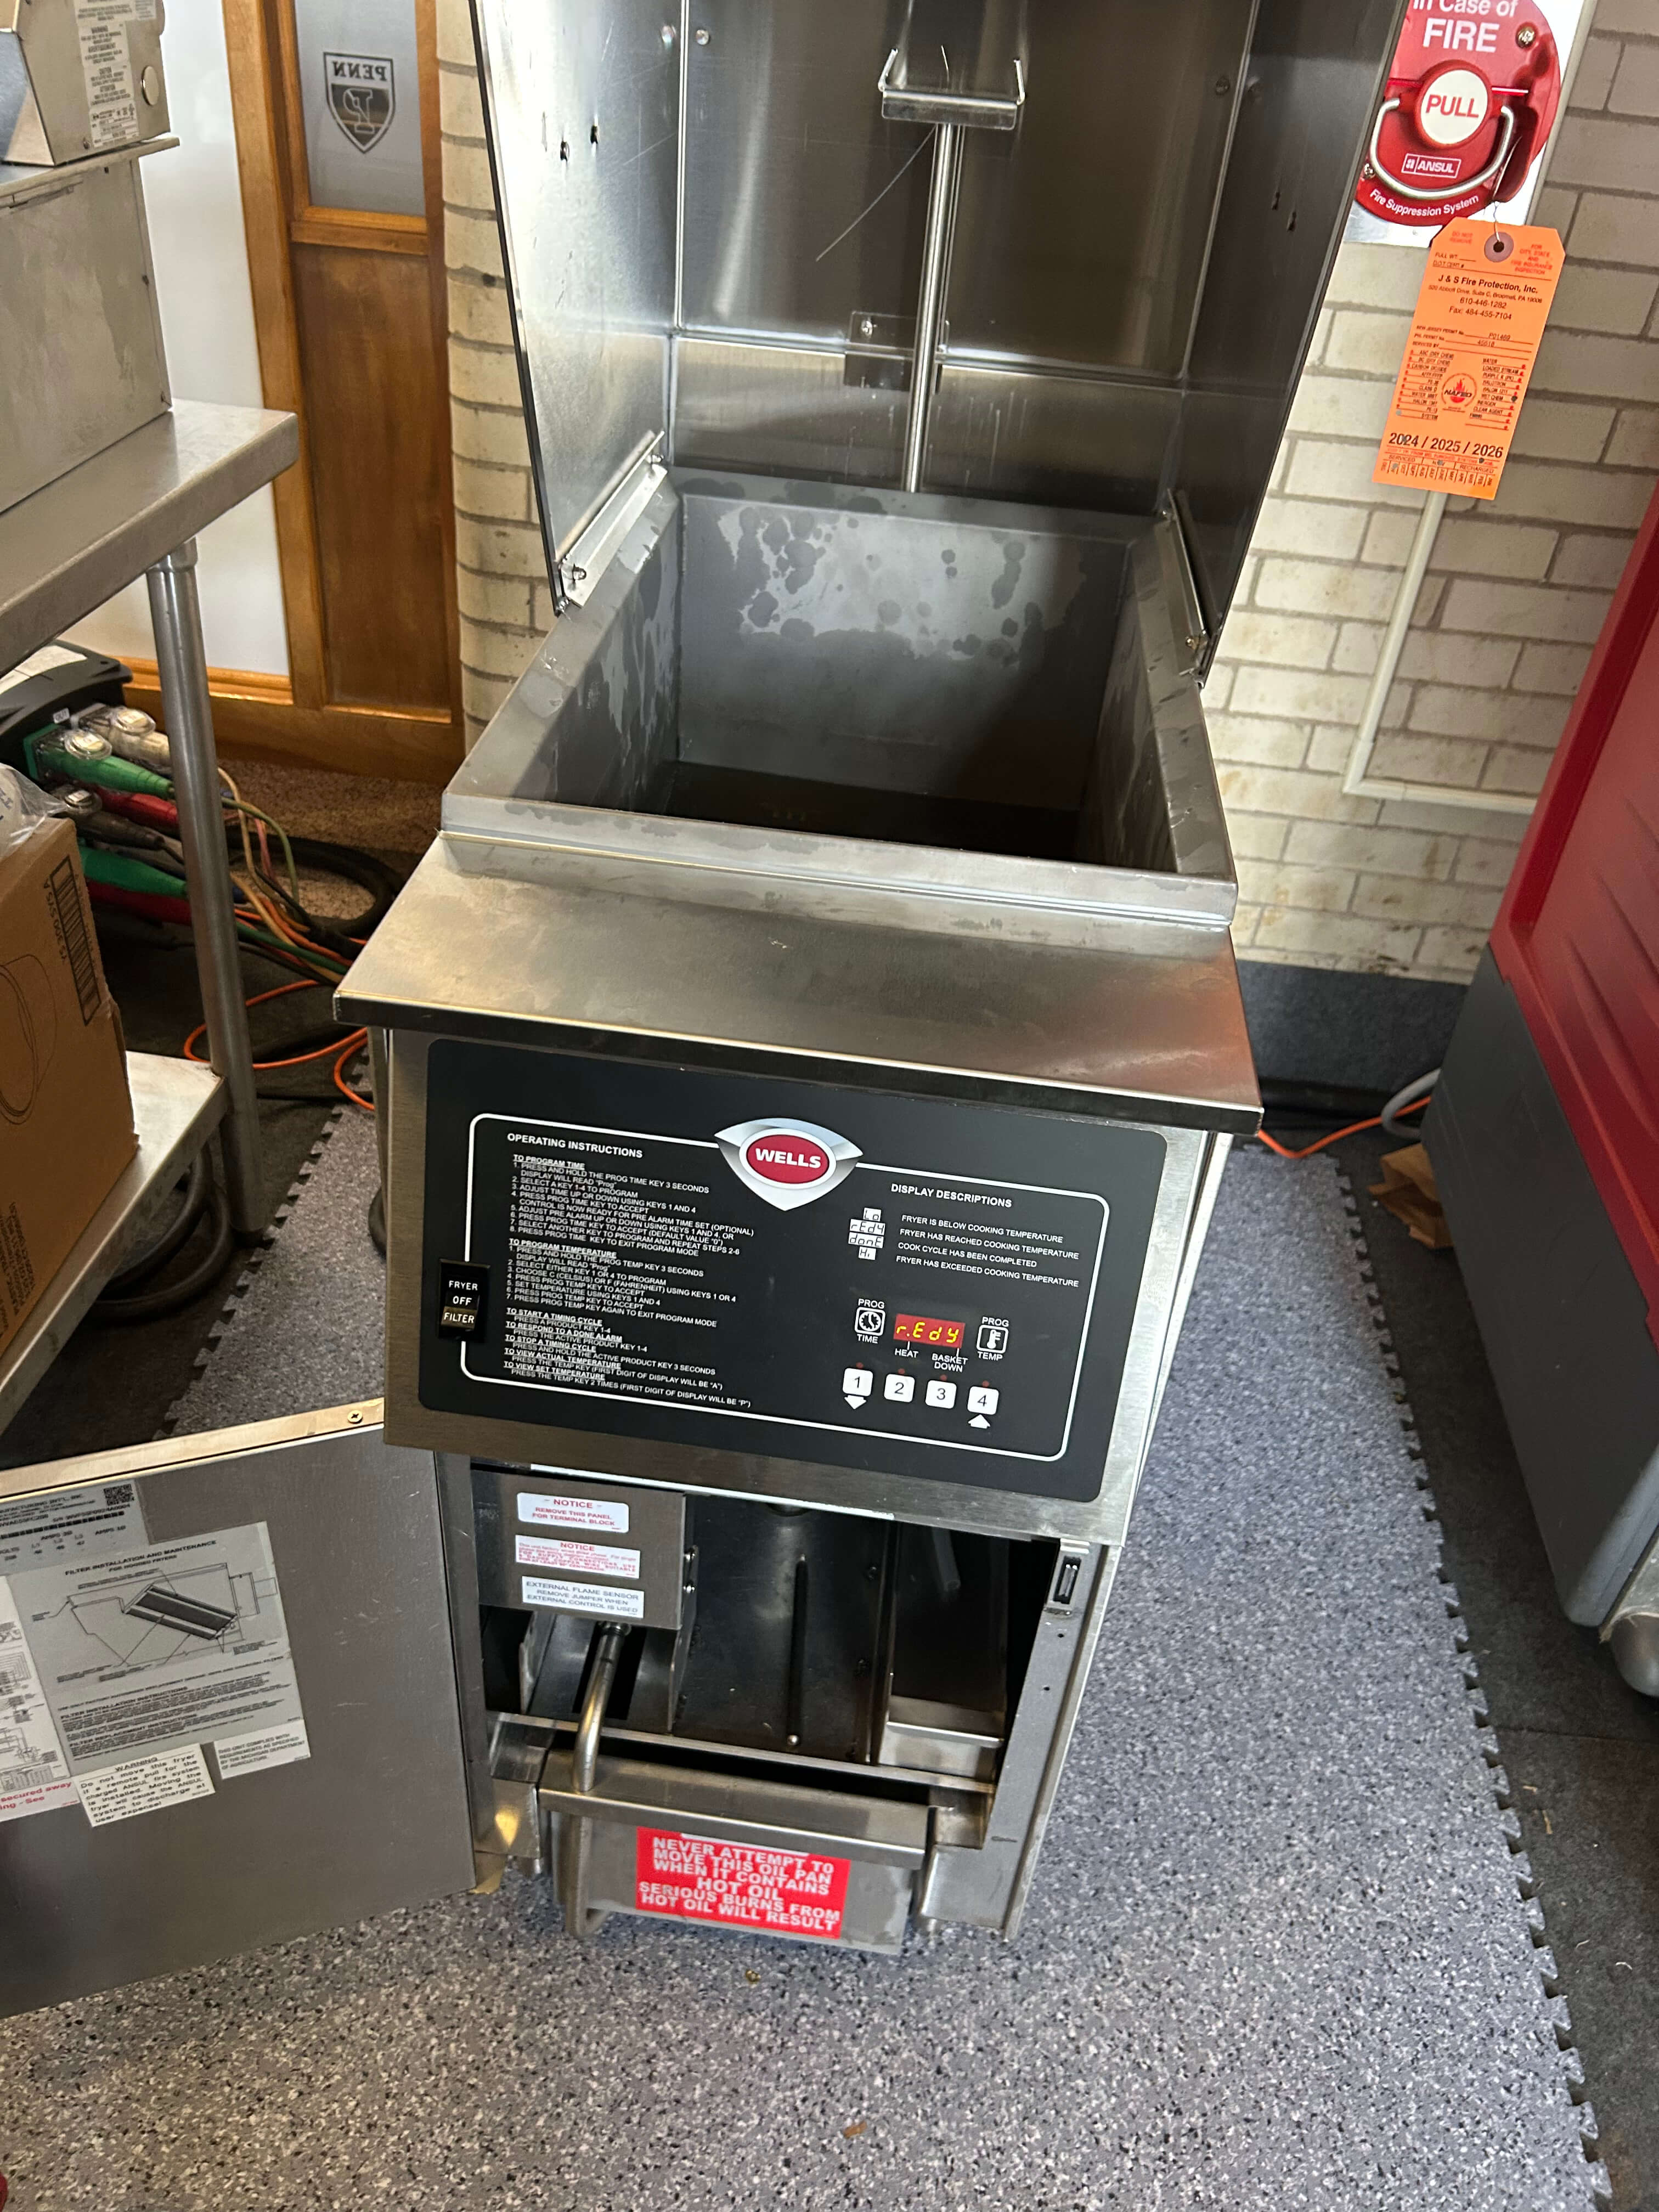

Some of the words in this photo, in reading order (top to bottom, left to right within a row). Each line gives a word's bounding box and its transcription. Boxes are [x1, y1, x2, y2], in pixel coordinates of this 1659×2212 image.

[1438, 0, 1491, 14] Case
[1496, 0, 1519, 17] of
[1423, 18, 1500, 53] FIRE
[1426, 94, 1479, 118] PULL
[1418, 160, 1454, 173] ANSUL
[1370, 189, 1386, 204] Fire
[1386, 199, 1441, 216] Suppression
[1443, 195, 1479, 215] System
[1462, 277, 1476, 286] Fire
[1479, 279, 1521, 293] Protection,
[1523, 285, 1538, 294] Inc.
[1449, 306, 1463, 314] Fax:
[1465, 308, 1512, 320] 484-455-7104
[1389, 432, 1419, 447] 2024
[1421, 436, 1429, 448] /
[1431, 438, 1461, 452] 2025
[1463, 441, 1470, 454] /
[1472, 443, 1503, 458] 2026
[507, 1133, 566, 1148] OPERATING
[568, 1141, 643, 1158] INSTRUCTIONS
[526, 1156, 565, 1166] PROGRAM
[567, 1161, 585, 1170] TIME
[755, 1148, 821, 1169] WELLS
[521, 1170, 552, 1180] DISPLAY
[521, 1163, 547, 1172] PRESS
[606, 1174, 628, 1182] PROG
[629, 1177, 647, 1185] TIME
[672, 1183, 709, 1193] SECONDS
[891, 1184, 934, 1197] DISPLAY
[936, 1189, 1012, 1207] DESCRIPTIONS
[902, 1215, 928, 1224] FRYER
[939, 1220, 966, 1229] BELOW
[968, 1224, 1004, 1235] COOKING
[1006, 1229, 1063, 1243] TEMPERATURE
[521, 1240, 560, 1251] PROGRAM
[562, 1245, 617, 1259] TEMPERATURE
[900, 1229, 926, 1238] FRYER
[945, 1235, 981, 1246] REACHED
[984, 1240, 1020, 1251] COOKING
[1022, 1245, 1079, 1259] TEMPERATURE
[898, 1242, 921, 1251] COOK
[922, 1245, 947, 1255] CYCLE
[950, 1249, 964, 1257] HAS
[967, 1251, 987, 1261] BEEN
[989, 1255, 1037, 1267] COMPLETED
[896, 1256, 921, 1265] FRYER
[923, 1260, 939, 1268] HAS
[941, 1262, 982, 1273] EXCEEDED
[984, 1268, 1020, 1279] COOKING
[1022, 1273, 1079, 1286] TEMPERATURE
[449, 1280, 478, 1290] FRYER
[453, 1296, 472, 1306] OFF
[858, 1299, 884, 1308] PROG
[444, 1312, 475, 1323] FILTER
[519, 1309, 543, 1317] START
[551, 1313, 576, 1322] TIMING
[578, 1317, 602, 1326] CYCLE
[981, 1317, 1009, 1327] PROG
[857, 1334, 878, 1344] TIME
[894, 1348, 918, 1358] HEAT
[932, 1353, 968, 1365] BASKET
[978, 1351, 1003, 1361] TEMP
[934, 1362, 963, 1372] DOWN
[854, 1376, 860, 1389] 1
[894, 1382, 904, 1395] 2
[936, 1388, 946, 1400] 3
[978, 1395, 987, 1407] 4
[554, 1499, 593, 1509] NOTICE
[550, 1515, 586, 1523] TERMINAL
[560, 1542, 594, 1551] NOTICE
[527, 1581, 570, 1591] EXTERNAL
[573, 1587, 600, 1595] FLAME
[603, 1590, 639, 1600] SENSOR
[537, 1589, 569, 1598] REMOVE
[572, 1594, 602, 1602] JUMPER
[528, 1595, 566, 1604] EXTERNAL
[569, 1600, 605, 1609] CONTROL
[100, 1775, 114, 1784] not
[121, 1768, 144, 1778] move
[151, 1761, 167, 1769] this
[173, 1754, 195, 1763] fryer
[115, 1757, 157, 1771] WARNING
[86, 1788, 117, 1800] charged
[172, 1766, 200, 1776] system
[108, 1776, 138, 1788] remote
[1, 1788, 42, 1802] secured
[46, 1782, 71, 1791] away
[653, 1837, 713, 1857] NEVER
[720, 1847, 803, 1869] ATTEMPT
[812, 1860, 834, 1874] TO
[654, 1849, 705, 1866] MOVE
[712, 1857, 753, 1873] THIS
[759, 1864, 788, 1878] OIL
[795, 1869, 831, 1884] PAN
[654, 1859, 707, 1877] WHEN
[714, 1868, 731, 1881] IT
[737, 1871, 829, 1895] CONTAINS
[698, 1877, 741, 1896] HOT
[748, 1884, 783, 1901] OIL
[639, 1881, 717, 1903] SERIOUS
[723, 1894, 783, 1912] BURNS
[790, 1904, 840, 1921] FROM
[642, 1893, 679, 1909] HOT
[684, 1899, 712, 1913] OIL
[719, 1904, 760, 1920] WILL
[768, 1911, 837, 1931] RESULT
